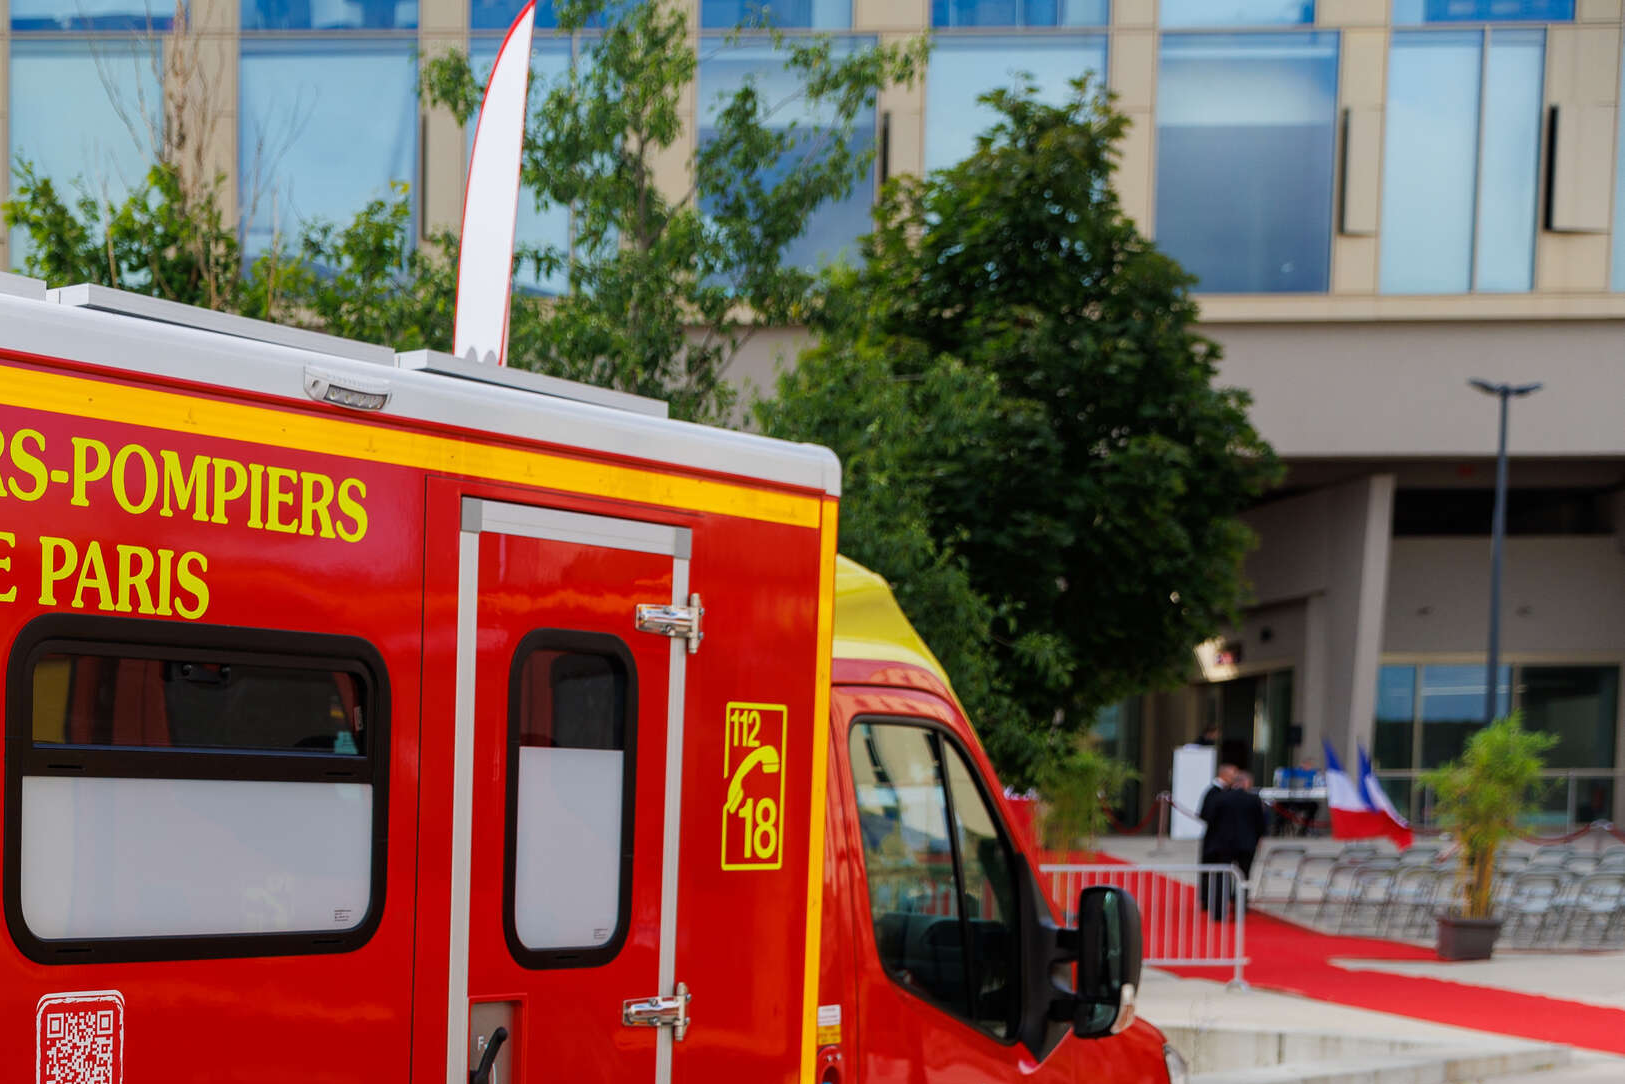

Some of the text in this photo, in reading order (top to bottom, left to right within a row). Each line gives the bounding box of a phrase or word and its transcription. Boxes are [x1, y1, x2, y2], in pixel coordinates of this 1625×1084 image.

[38, 535, 210, 621] PARIS
[730, 709, 761, 747] 112
[738, 797, 777, 860] 18
